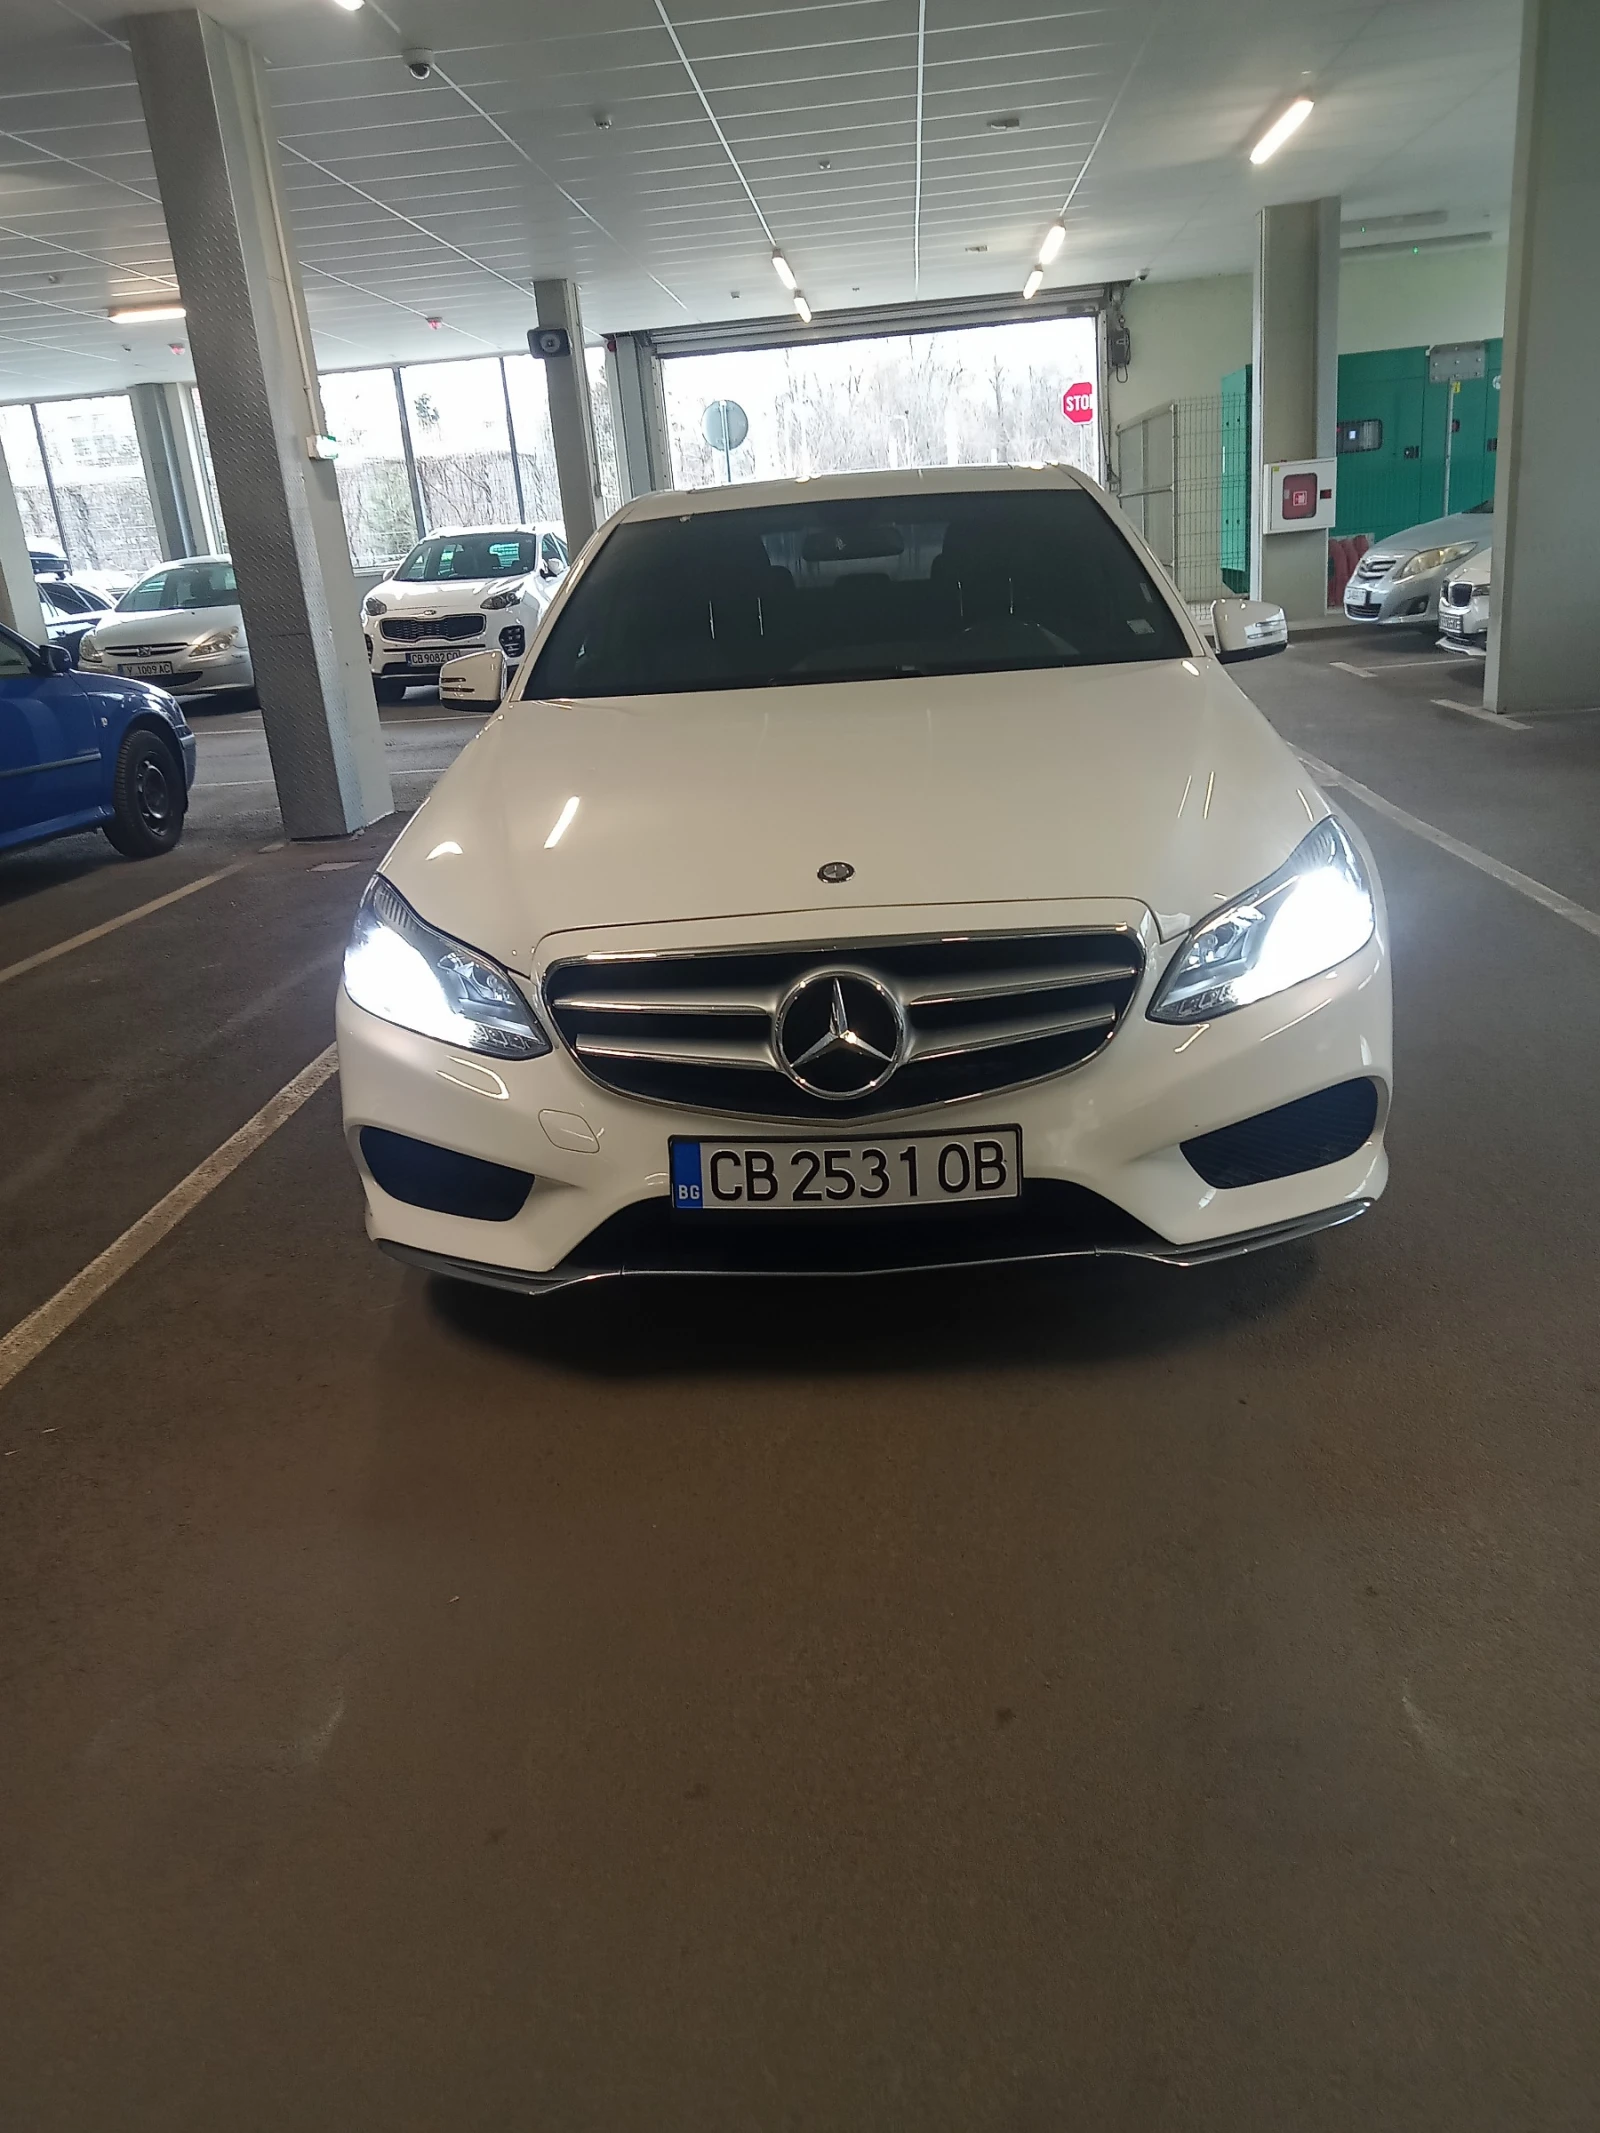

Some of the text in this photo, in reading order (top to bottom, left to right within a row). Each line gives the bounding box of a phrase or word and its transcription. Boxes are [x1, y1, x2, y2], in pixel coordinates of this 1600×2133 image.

[1066, 394, 1092, 411] STO
[412, 654, 423, 664] CB
[424, 653, 445, 663] 9082
[138, 665, 157, 675] 1009
[710, 1140, 1007, 1202] CB 2531 OB
[678, 1184, 700, 1200] BG
